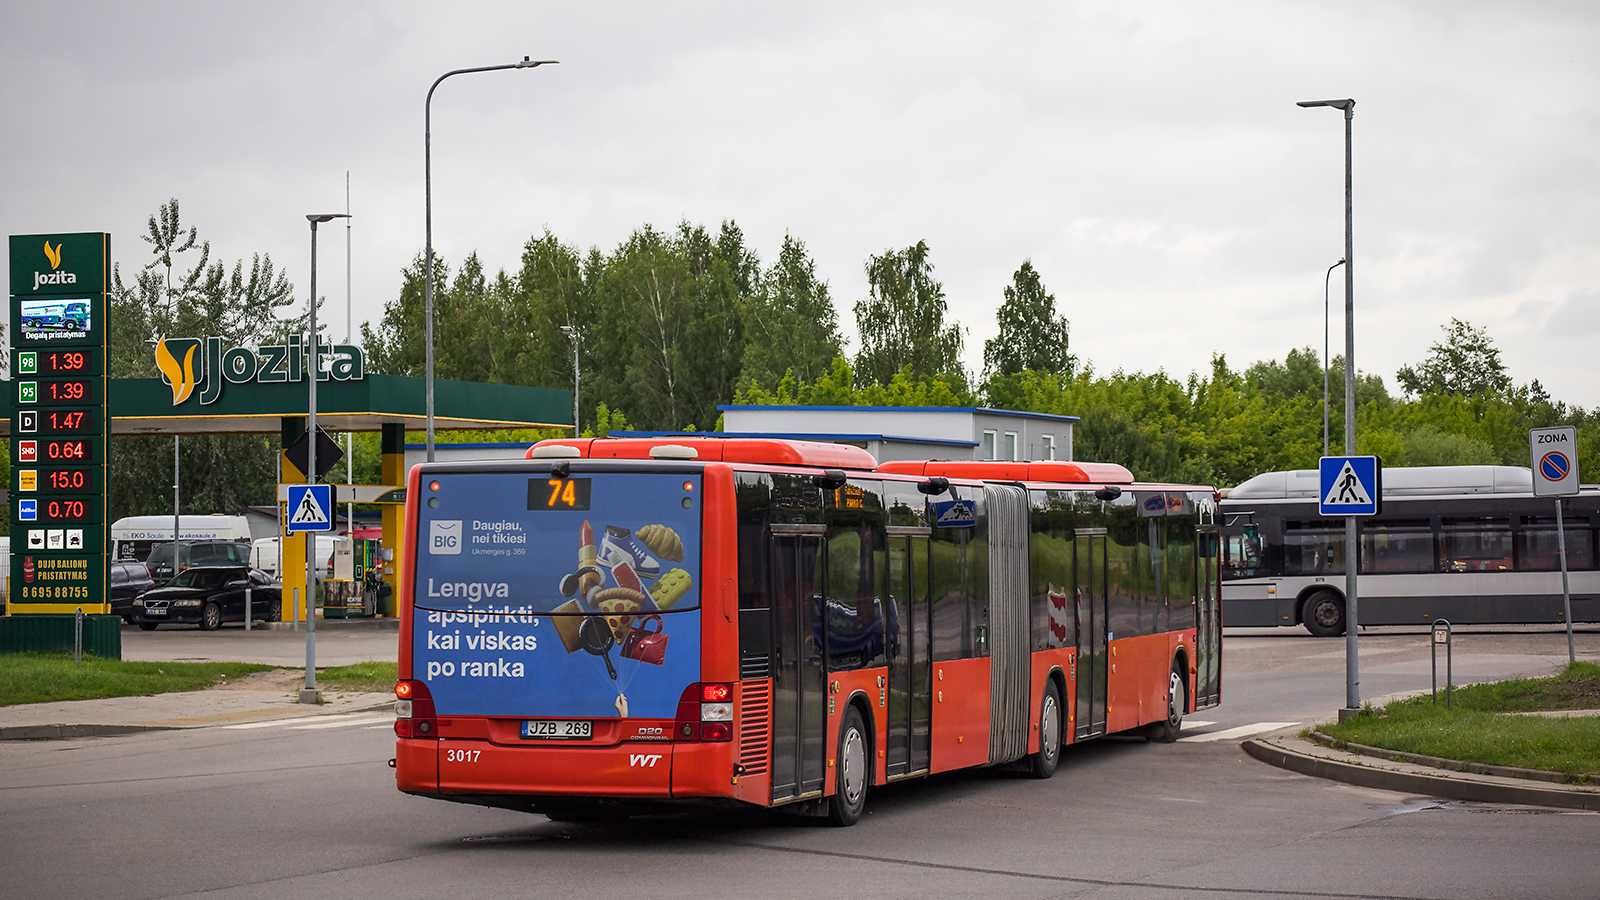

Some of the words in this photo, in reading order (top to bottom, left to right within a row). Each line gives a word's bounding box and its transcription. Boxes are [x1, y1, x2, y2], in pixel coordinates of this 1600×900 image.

[33, 271, 77, 291] Jozita
[48, 331, 86, 340] pristatymas
[22, 357, 34, 367] 98
[49, 352, 84, 370] 1.39
[200, 334, 364, 405] Jozita
[22, 387, 34, 397] 95
[49, 382, 84, 399] 1.39
[24, 417, 32, 427] D
[49, 411, 84, 429] 1.47
[1538, 433, 1568, 444] ZONA
[21, 447, 35, 455] SND
[48, 441, 84, 459] 0.64
[49, 471, 84, 488] 15.0
[352, 488, 357, 500] 1
[548, 480, 576, 506] 74
[48, 501, 84, 518] 0.70
[472, 520, 522, 532] Daugiau,
[434, 535, 457, 548] BIG
[472, 534, 490, 544] nei
[492, 533, 526, 544] tikiesi
[37, 559, 56, 570] DUJŲ
[56, 559, 88, 570] BALIONŲ
[37, 571, 88, 581] PRISTATYMAS
[22, 586, 29, 598] 8
[31, 586, 52, 598] 695
[54, 586, 88, 598] 88755
[428, 578, 509, 602] Lengva
[427, 604, 540, 628] apsipirkti,
[427, 629, 460, 650] kai
[466, 629, 537, 651] viskas
[427, 661, 456, 681] po
[461, 657, 525, 677] ranka
[529, 722, 557, 735] JZB
[565, 722, 589, 735] 269
[638, 727, 663, 735] D20
[446, 750, 481, 763] 3017
